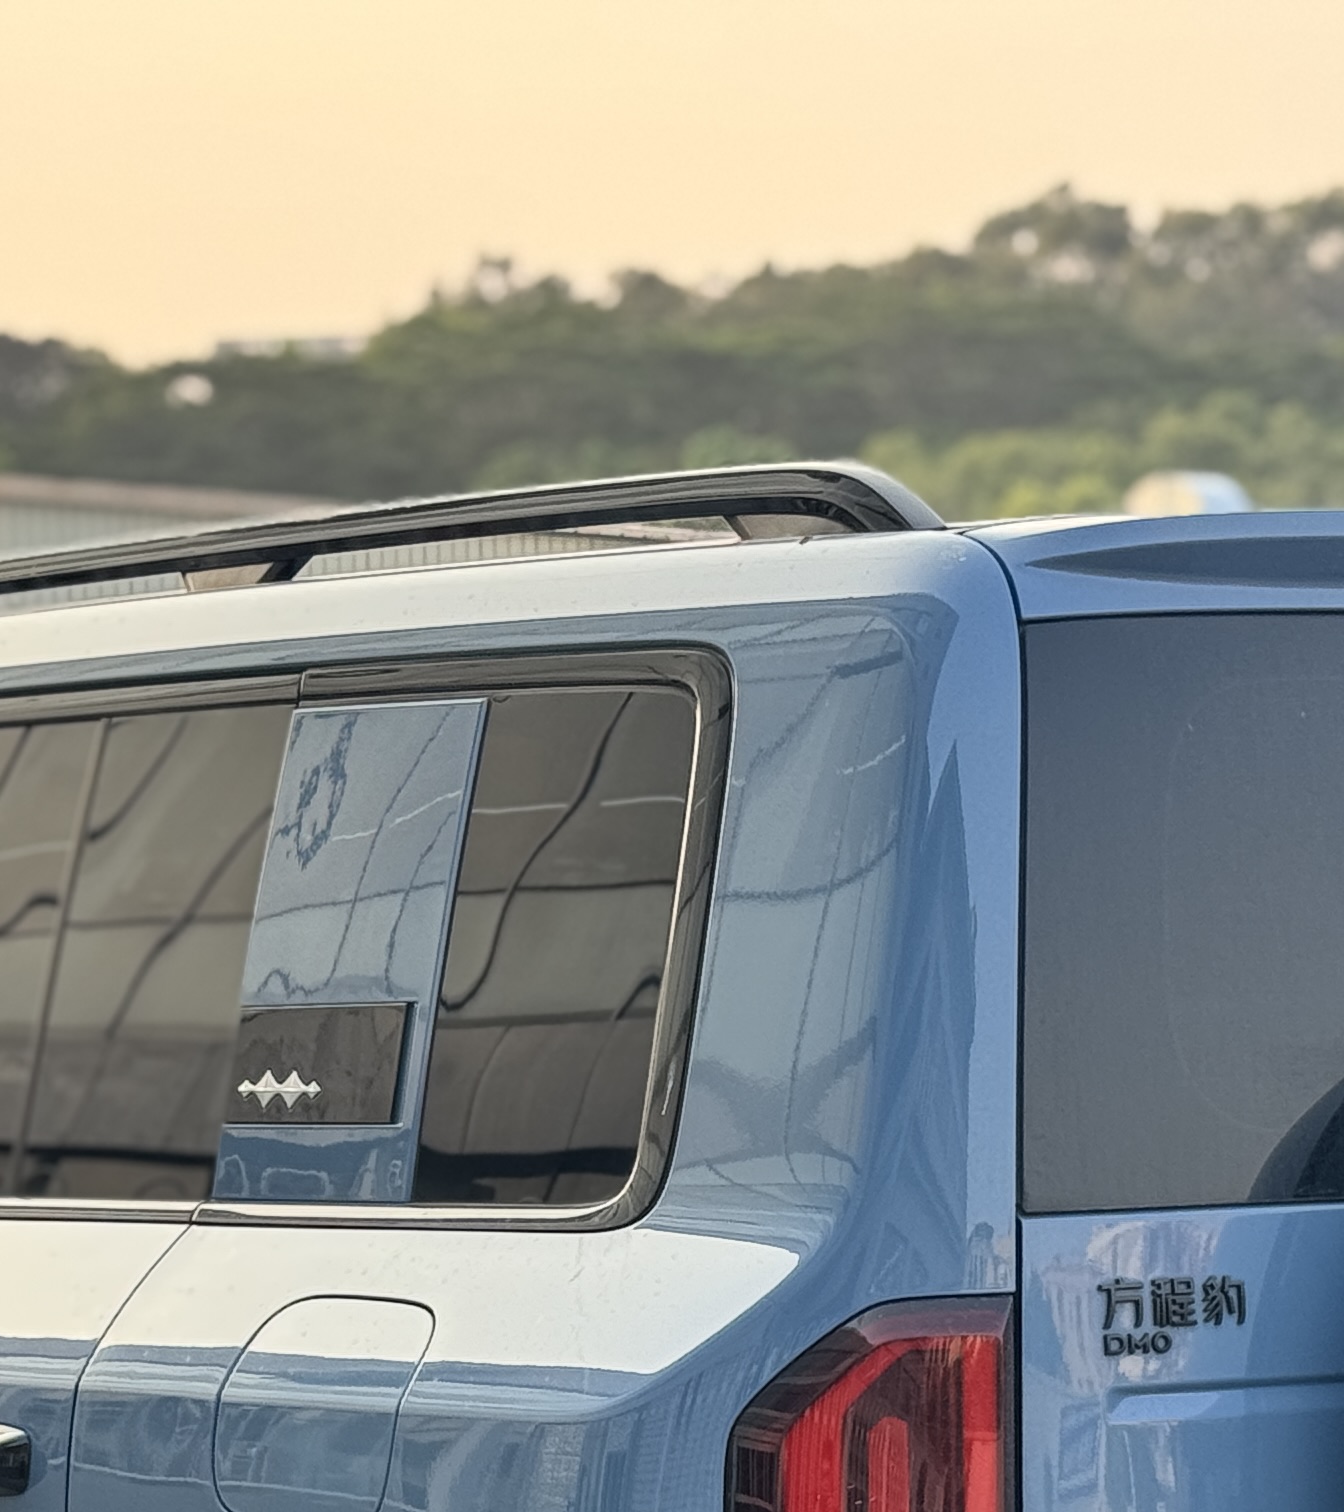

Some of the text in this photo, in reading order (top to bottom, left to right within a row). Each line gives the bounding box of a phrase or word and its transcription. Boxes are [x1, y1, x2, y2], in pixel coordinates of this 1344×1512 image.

[1097, 1275, 1246, 1330] 方程豹
[1103, 1331, 1173, 1357] DMO
